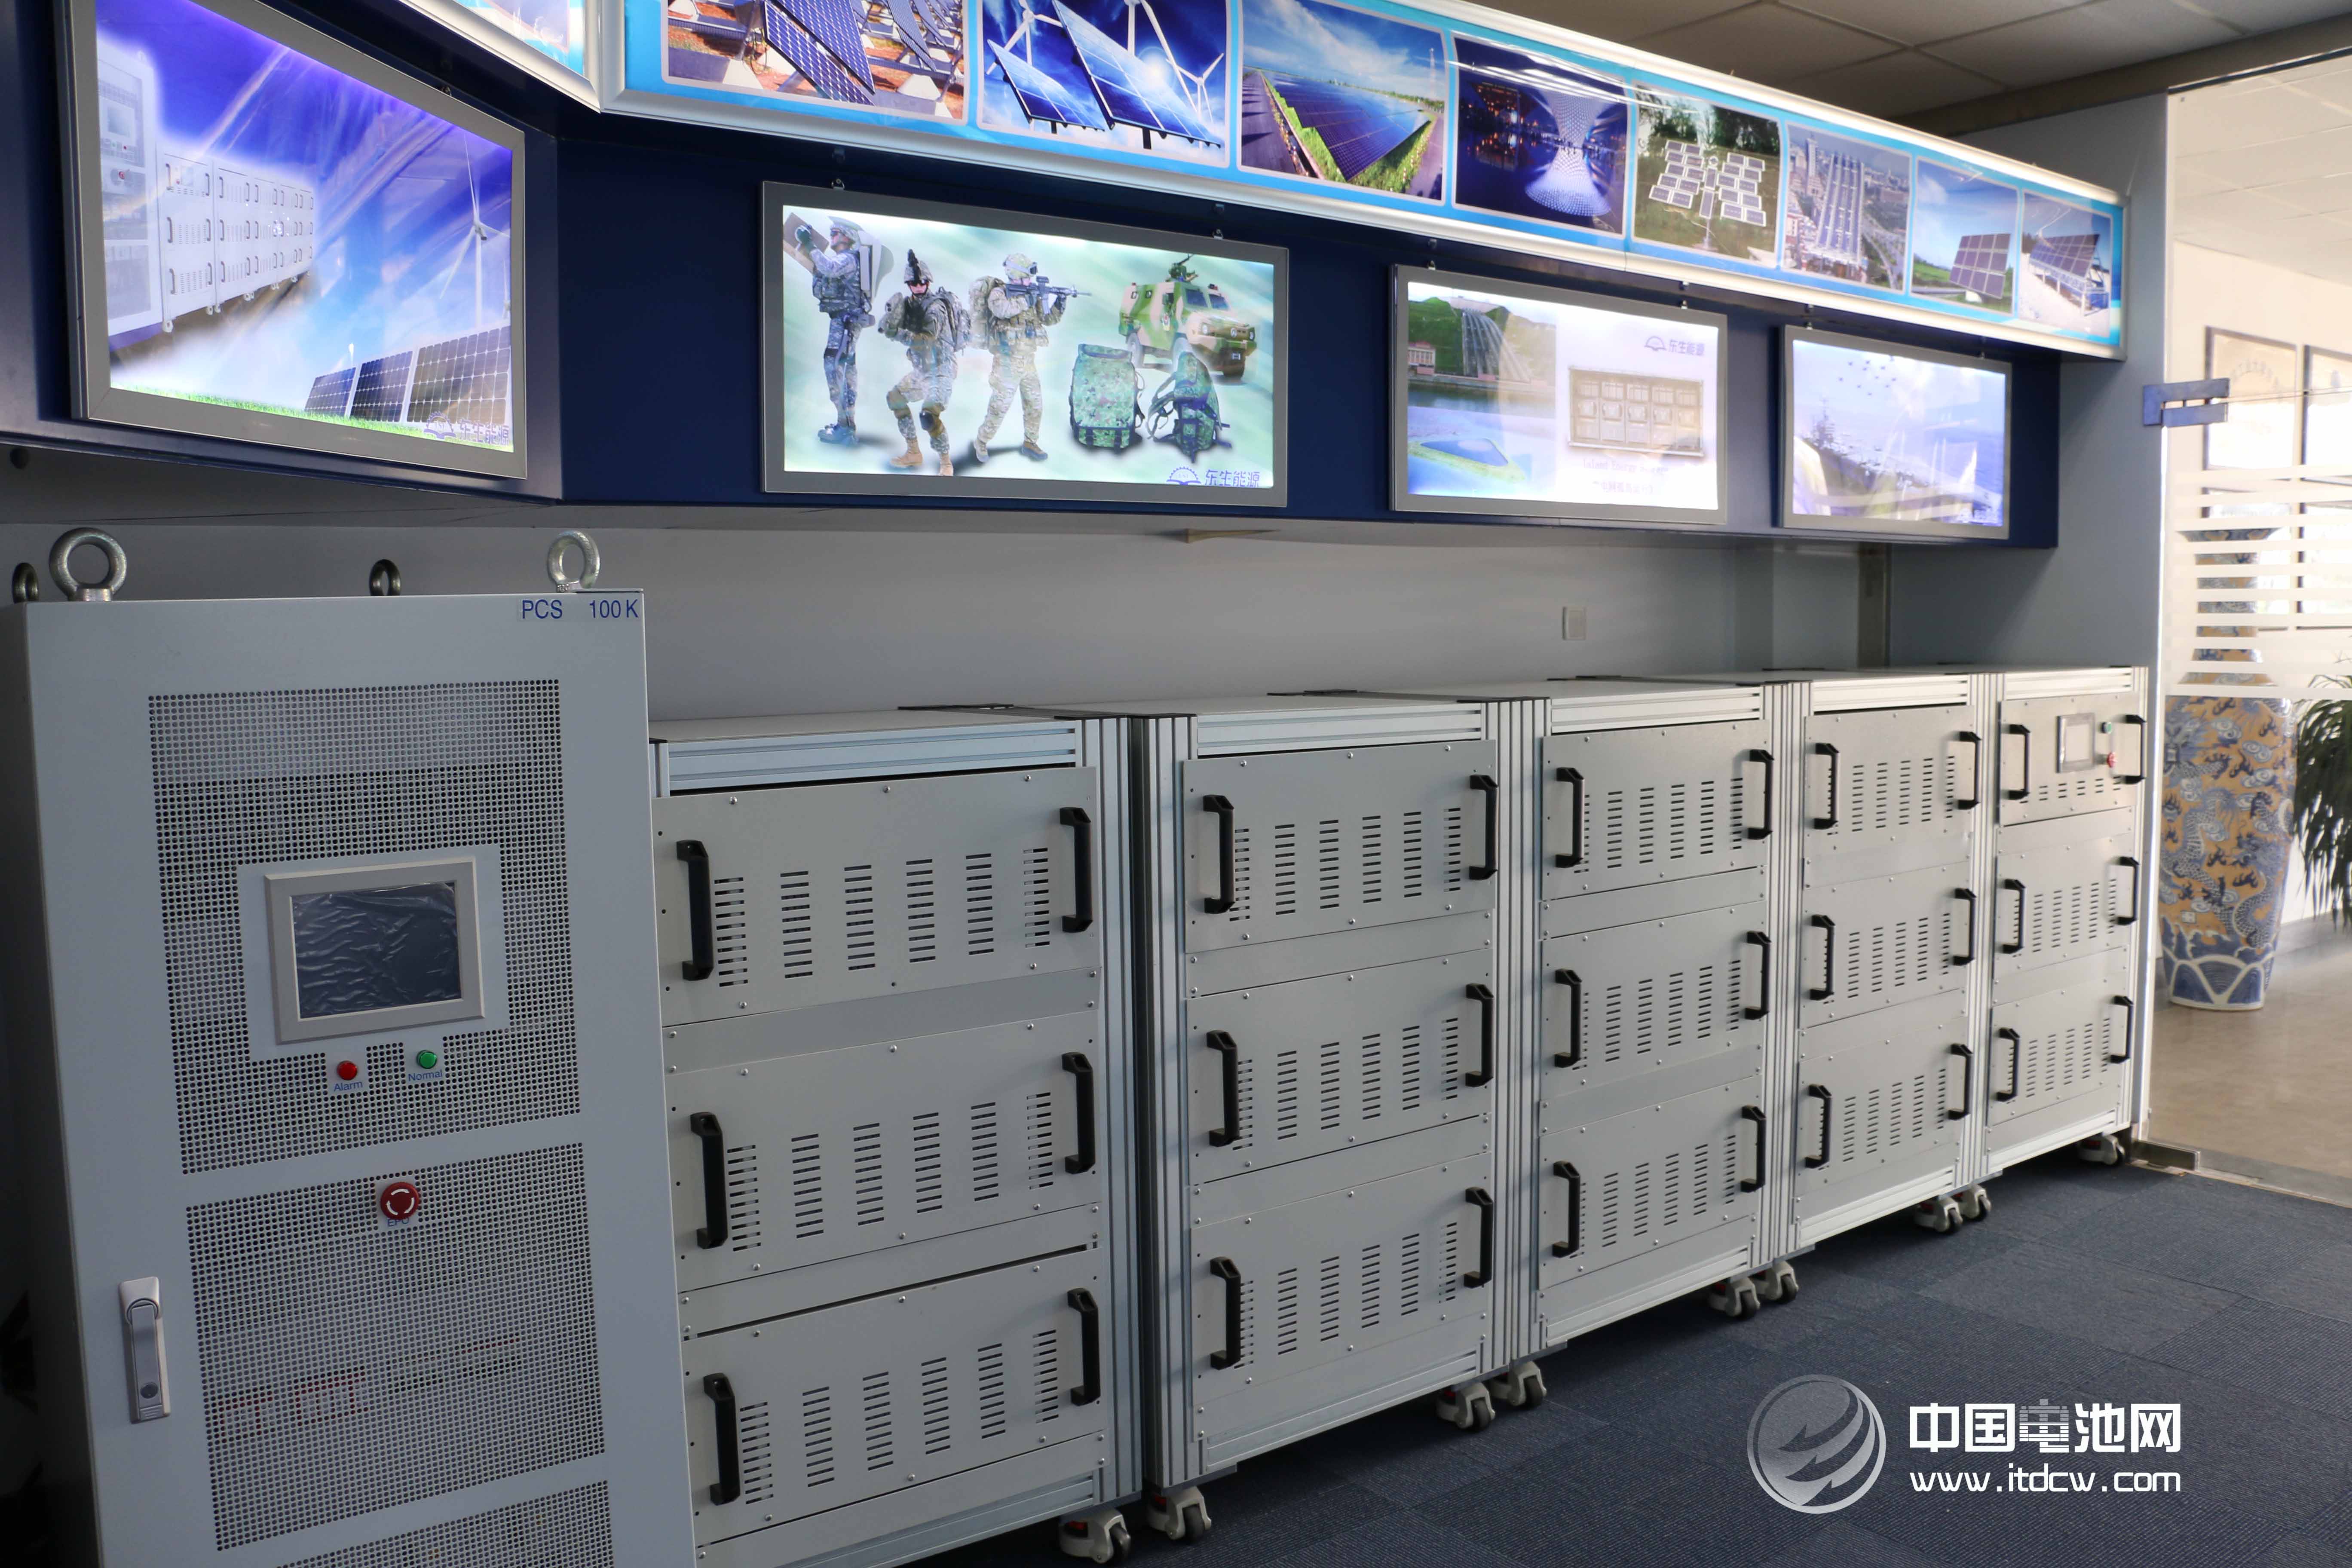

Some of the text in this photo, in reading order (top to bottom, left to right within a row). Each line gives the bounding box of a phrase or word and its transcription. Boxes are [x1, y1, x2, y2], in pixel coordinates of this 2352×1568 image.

[1204, 469, 1260, 487] 东生能源
[522, 599, 563, 619] PCS
[589, 600, 622, 618] 100
[408, 1069, 443, 1081] Normal
[334, 1081, 363, 1092] Alarm
